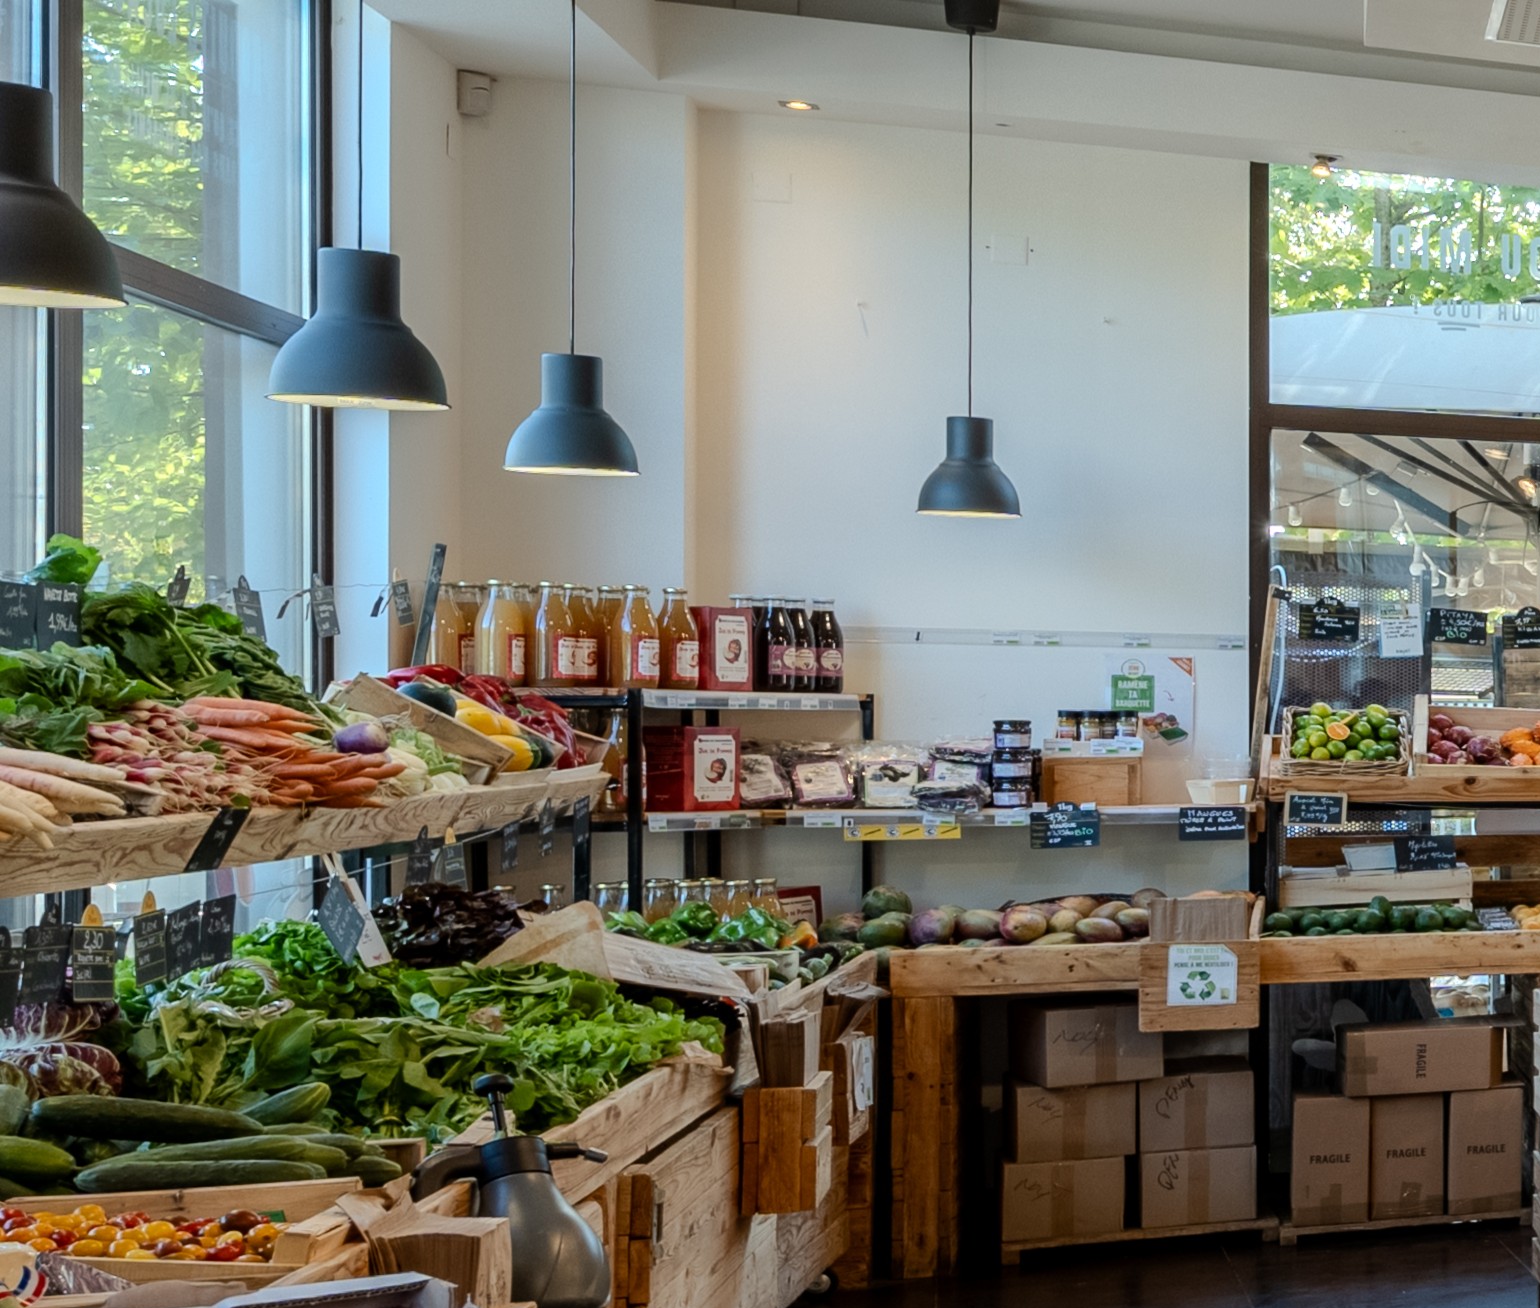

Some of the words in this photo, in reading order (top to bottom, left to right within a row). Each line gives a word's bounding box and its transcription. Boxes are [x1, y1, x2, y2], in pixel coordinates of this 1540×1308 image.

[1415, 1043, 1428, 1079] FRAGILE
[1386, 1147, 1427, 1159] FRAGILE
[1466, 1143, 1506, 1155] FRAGILE
[1309, 1153, 1352, 1165] FRAGILE
